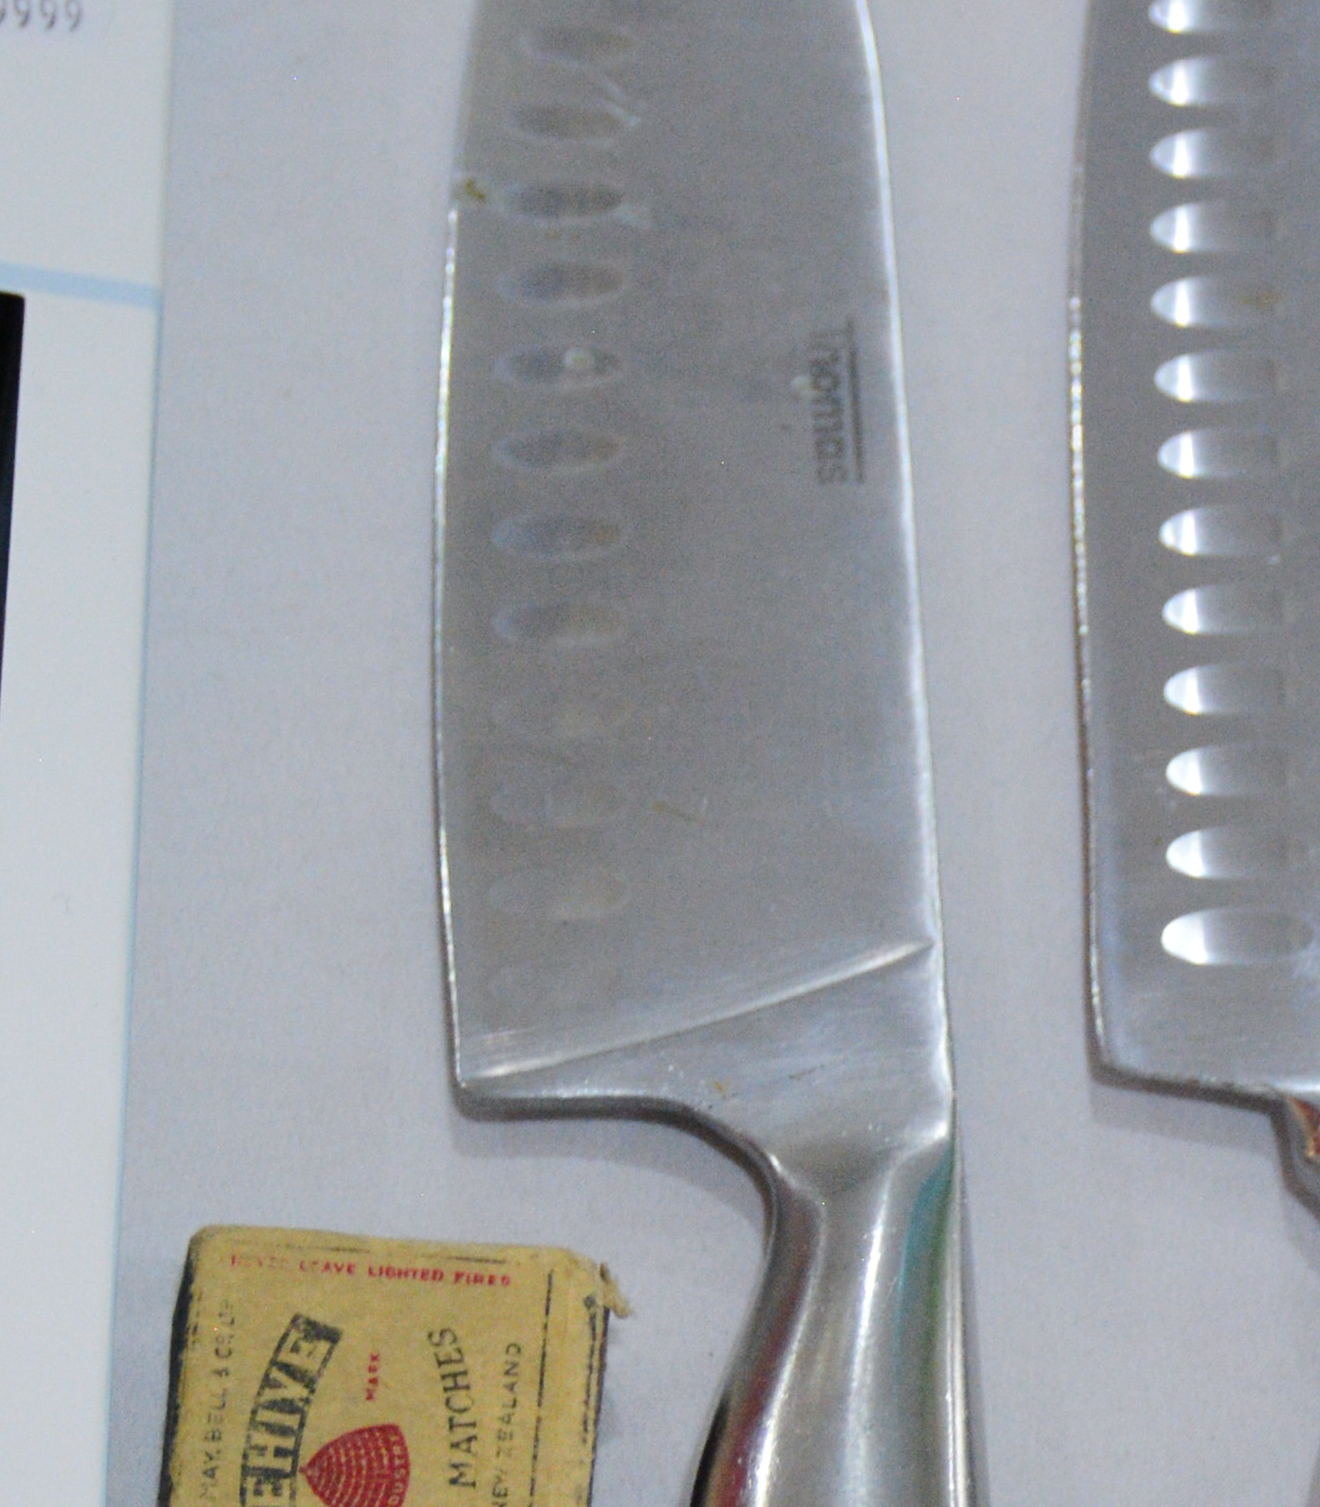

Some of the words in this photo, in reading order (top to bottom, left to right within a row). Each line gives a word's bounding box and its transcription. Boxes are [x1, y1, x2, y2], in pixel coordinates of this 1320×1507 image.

[367, 1264, 445, 1283] LIGHTED
[364, 1351, 381, 1403] MARK
[427, 1327, 479, 1490] MATCHES
[495, 1342, 522, 1459] ZEALAND
